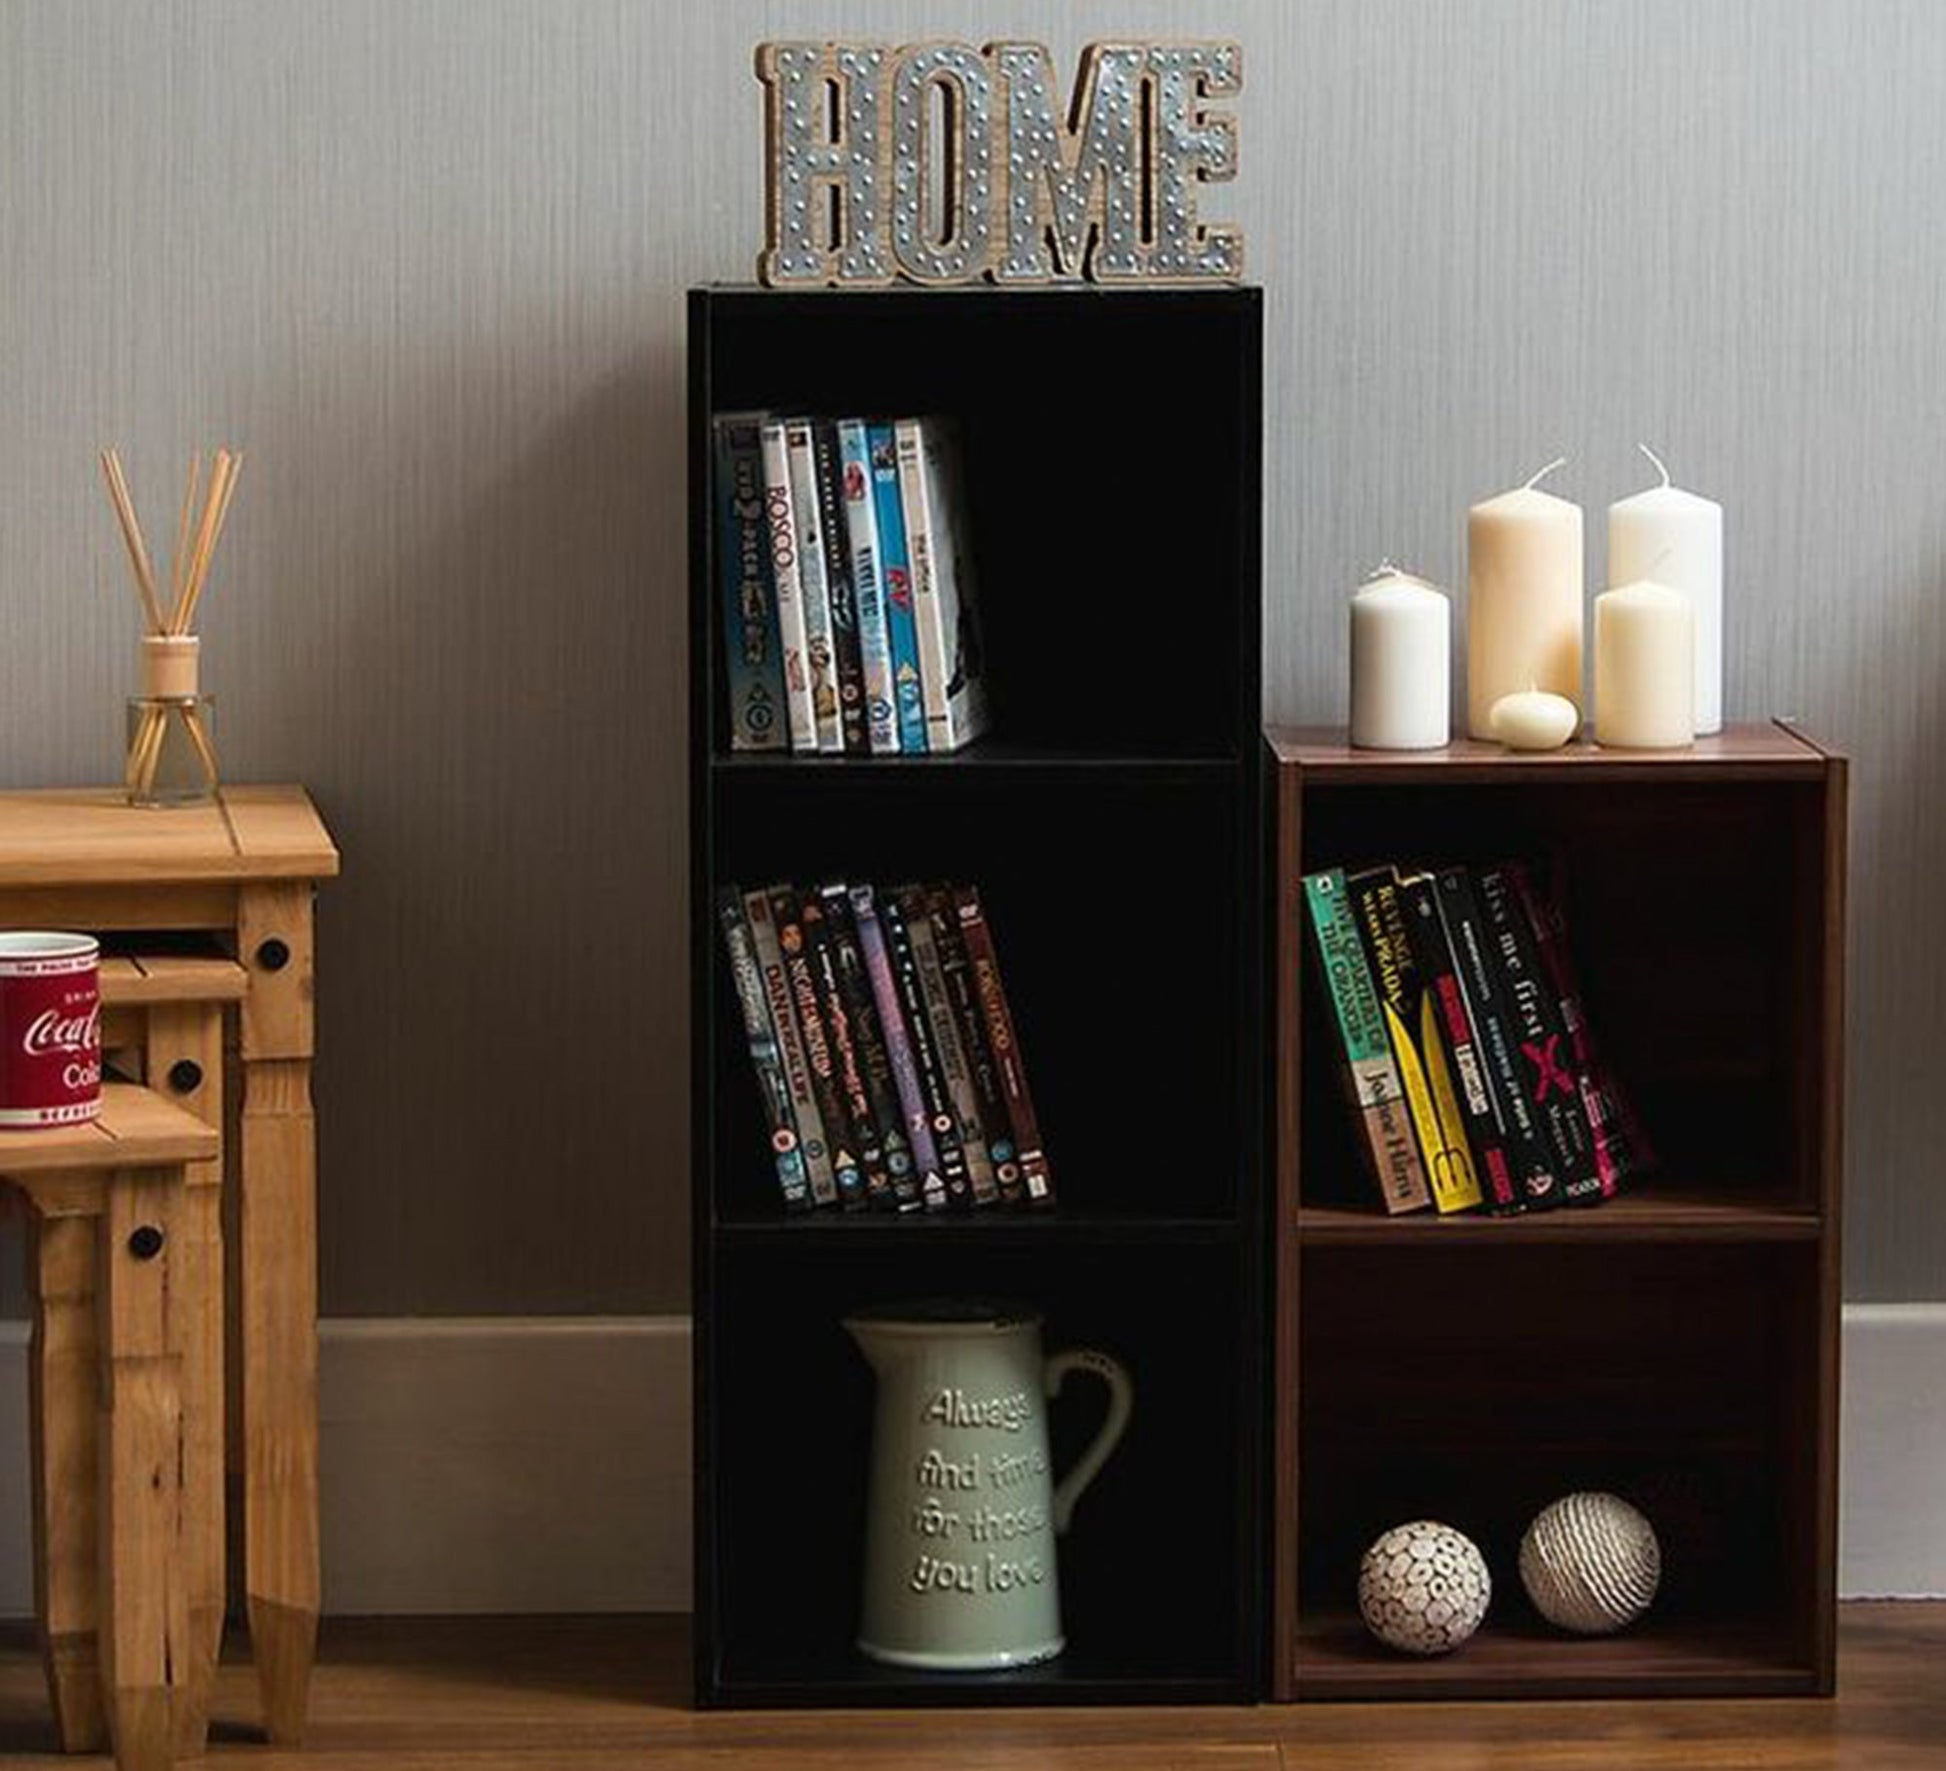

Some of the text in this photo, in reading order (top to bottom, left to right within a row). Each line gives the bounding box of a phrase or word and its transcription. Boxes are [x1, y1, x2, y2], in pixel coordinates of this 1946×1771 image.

[757, 42, 1242, 286] HOME
[767, 485, 795, 568] BOSCO
[1320, 921, 1346, 957] THE
[1332, 893, 1357, 929] FIVE
[1377, 885, 1413, 970] REVENGE
[1342, 935, 1382, 1027] QUARTERS
[1374, 935, 1403, 1004] PRADA
[1482, 873, 1508, 922] kiss
[1498, 931, 1522, 972] me
[1514, 979, 1544, 1036] first
[766, 963, 788, 1012] DAN
[781, 1032, 799, 1072] REAL
[792, 1071, 809, 1102] LIFE
[1364, 1070, 1399, 1139] Joanne
[922, 1389, 1032, 1432] Always
[918, 1448, 1048, 1491] find time
[915, 1498, 1047, 1543] for those
[910, 1552, 1044, 1594] you love
